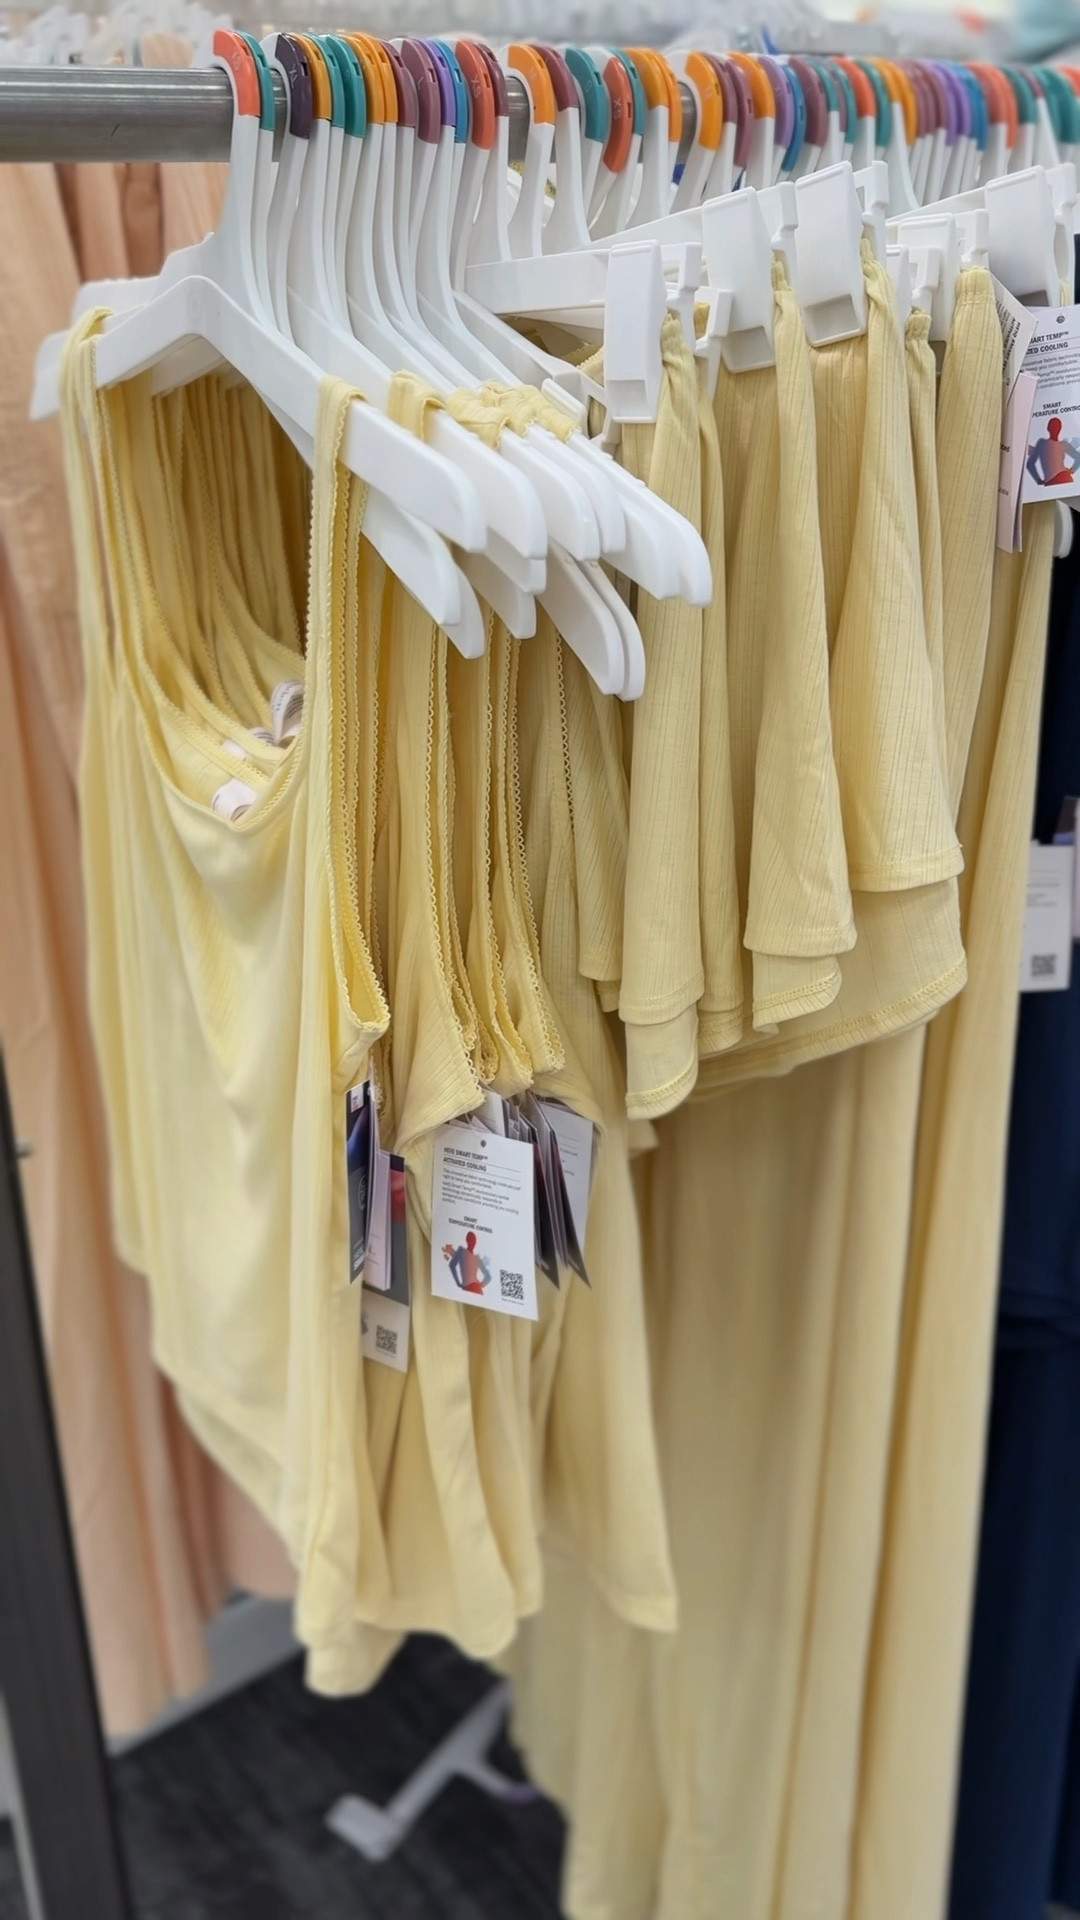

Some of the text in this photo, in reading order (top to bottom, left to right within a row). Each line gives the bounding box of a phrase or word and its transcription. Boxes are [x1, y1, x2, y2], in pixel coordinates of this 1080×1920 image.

[289, 63, 298, 89] XL
[471, 74, 481, 98] XS
[613, 98, 622, 119] XS
[1040, 342, 1069, 353] COOLING
[1042, 401, 1061, 409] SMART
